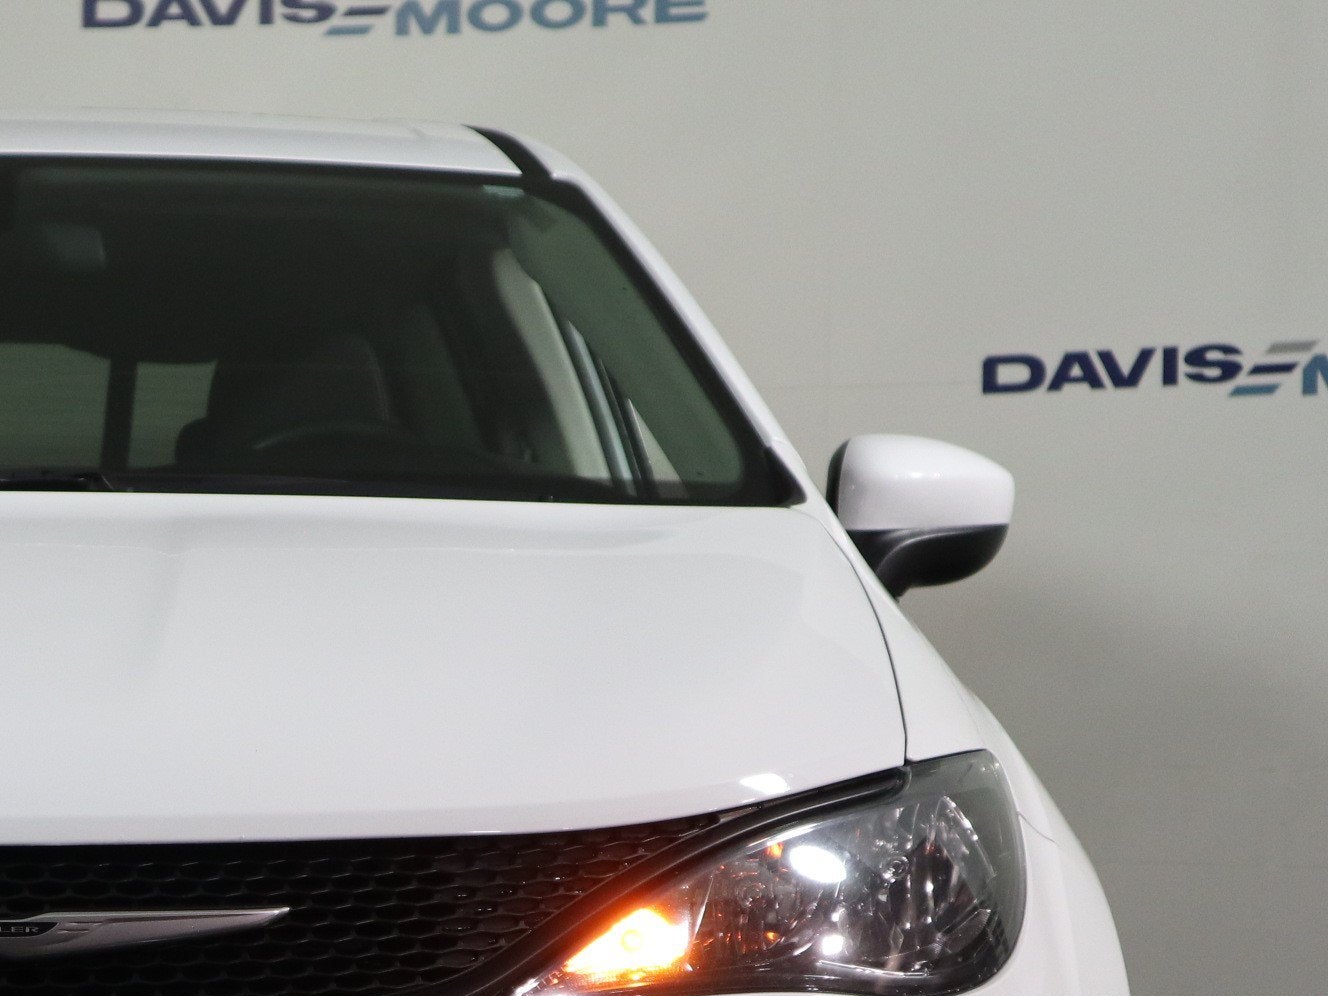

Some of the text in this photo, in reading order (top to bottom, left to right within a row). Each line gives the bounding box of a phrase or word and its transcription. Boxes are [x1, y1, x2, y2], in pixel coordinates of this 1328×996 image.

[82, 0, 709, 36] DAVIS MOORE
[982, 343, 1243, 395] DAVIS
